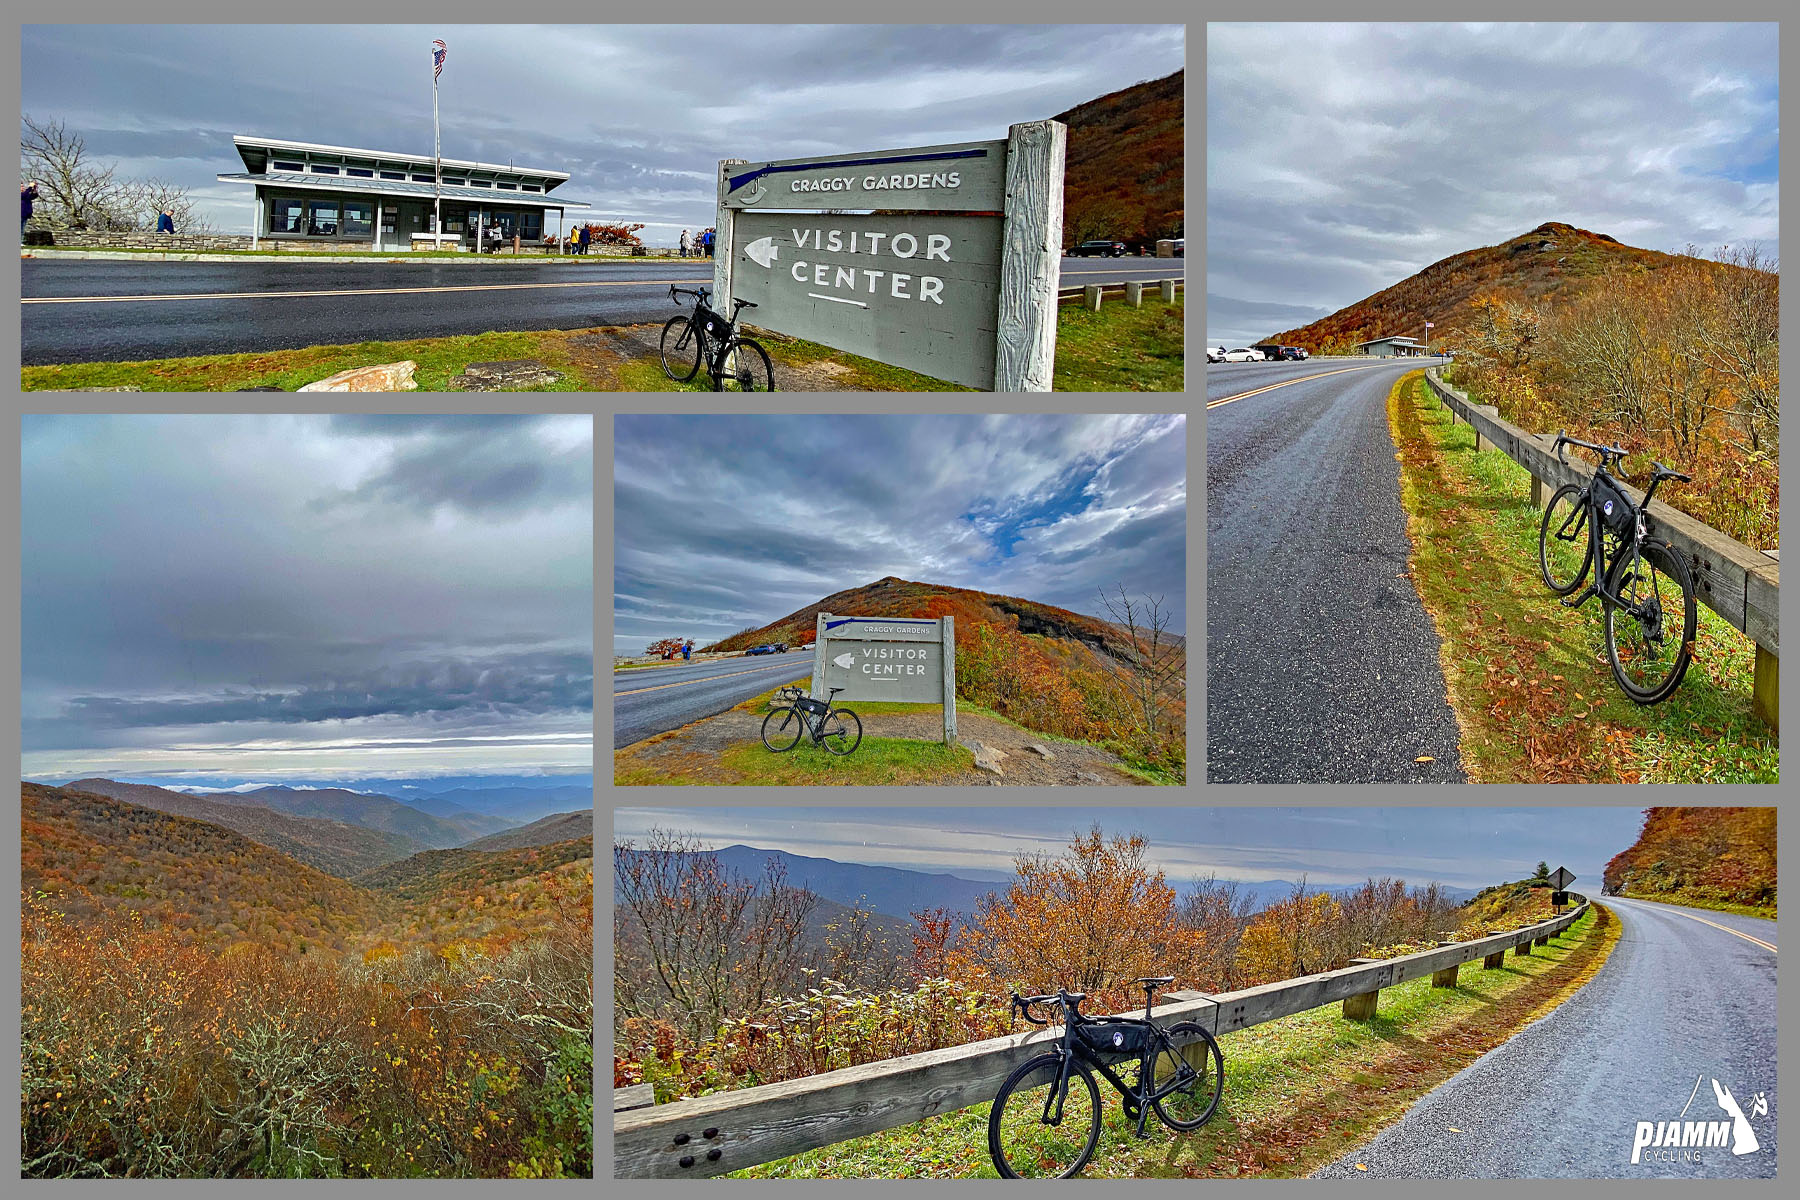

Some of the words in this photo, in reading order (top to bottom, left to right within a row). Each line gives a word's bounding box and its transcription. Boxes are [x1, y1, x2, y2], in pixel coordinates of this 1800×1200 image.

[791, 177, 855, 192] CRAGGY
[862, 172, 961, 190] GARDENS
[792, 228, 951, 263] VISITOR
[791, 261, 944, 305] CENTER
[863, 625, 893, 633] CRAGGY
[896, 626, 930, 634] GARDENS
[862, 648, 927, 660] VISITOR
[862, 663, 926, 675] CENTER
